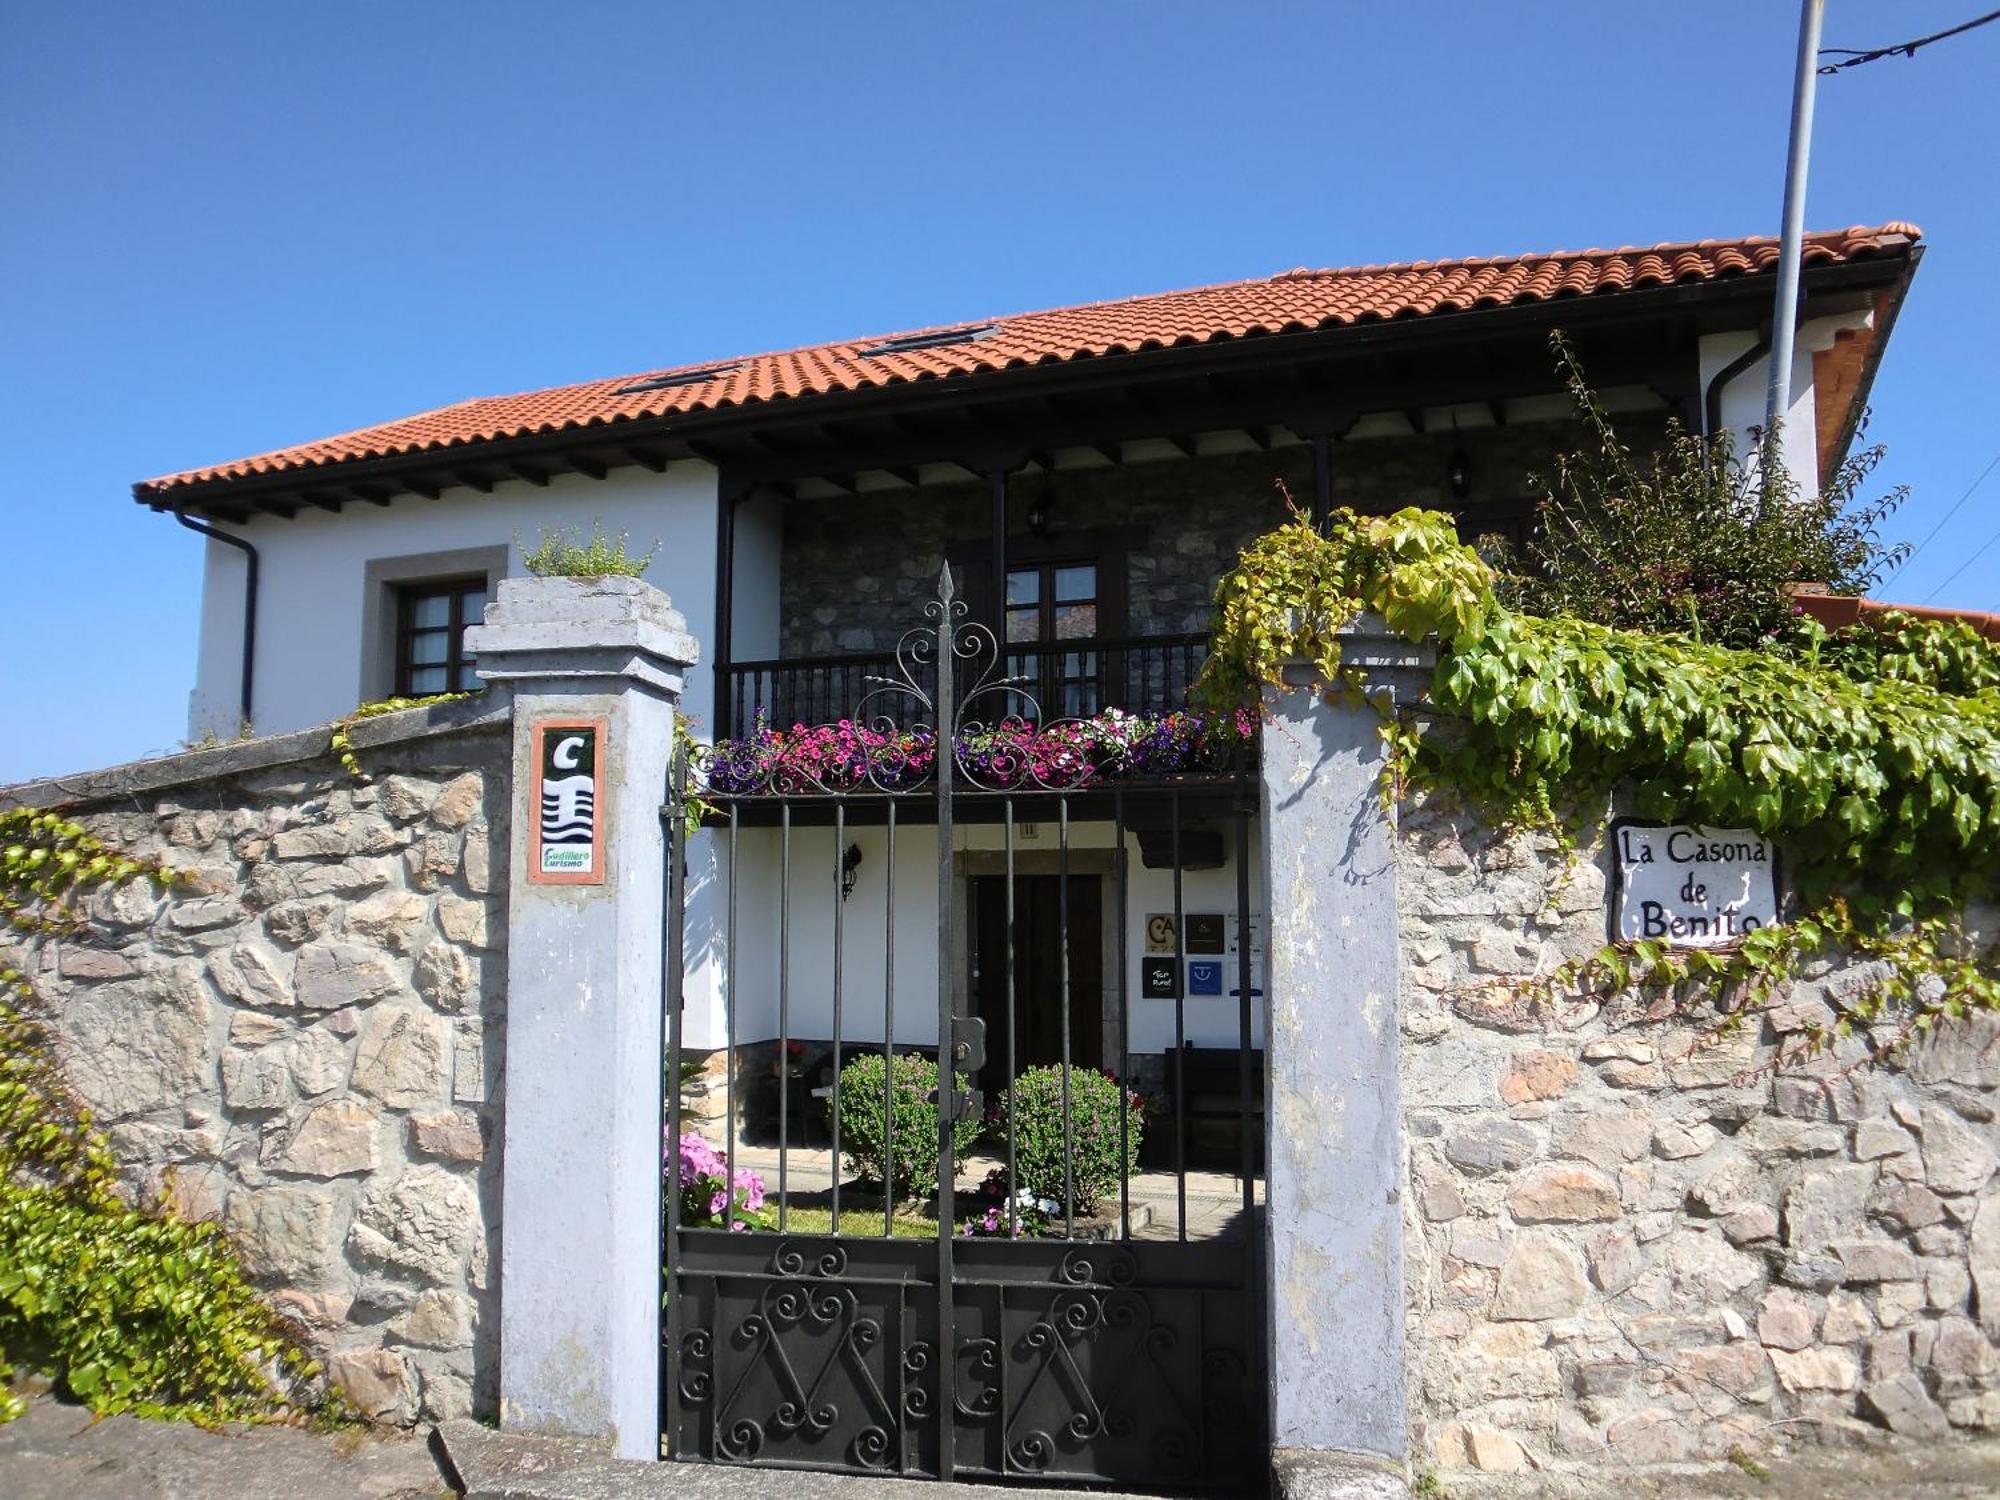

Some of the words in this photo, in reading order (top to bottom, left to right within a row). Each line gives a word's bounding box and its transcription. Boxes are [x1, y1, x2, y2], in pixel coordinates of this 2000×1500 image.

[1621, 830, 1654, 864] La
[1667, 831, 1768, 864] Casona
[1680, 871, 1708, 904] de
[1640, 900, 1762, 939] Benito
